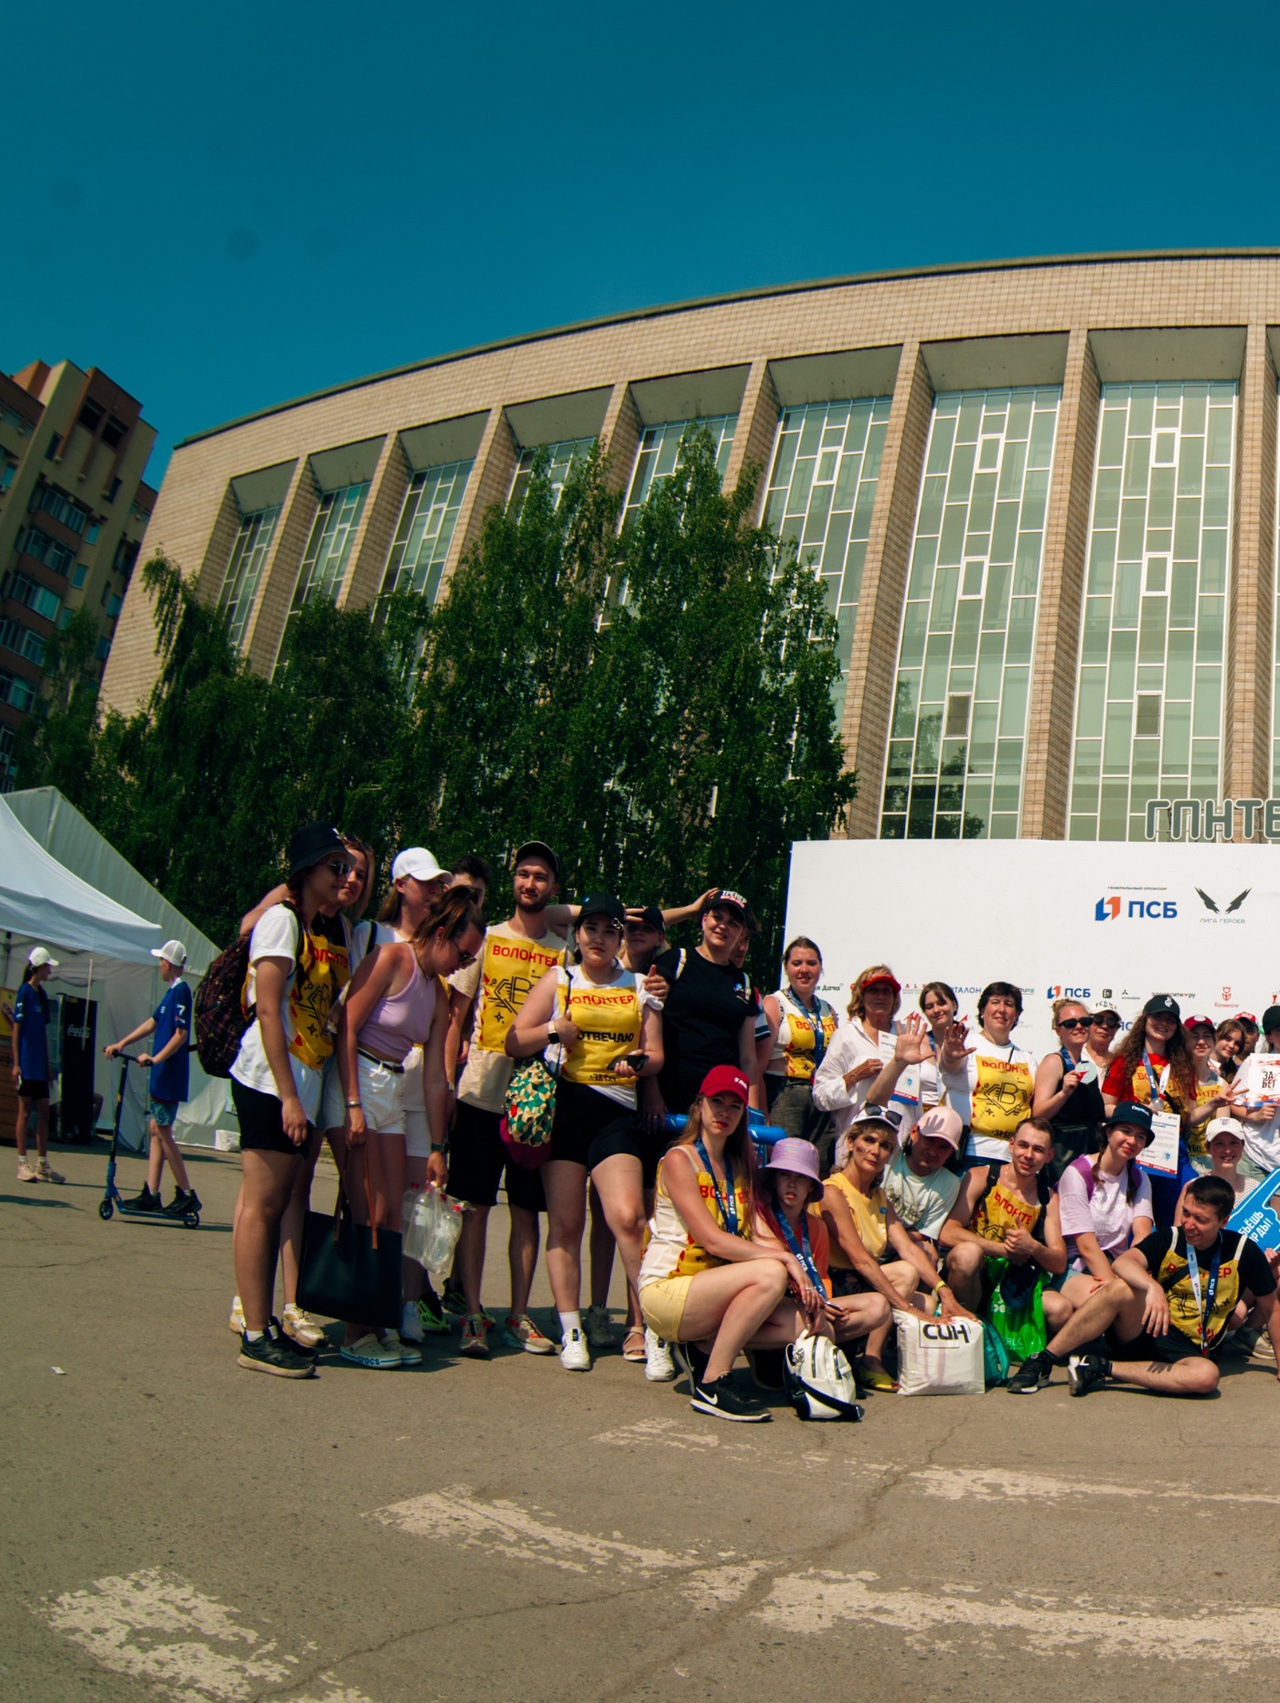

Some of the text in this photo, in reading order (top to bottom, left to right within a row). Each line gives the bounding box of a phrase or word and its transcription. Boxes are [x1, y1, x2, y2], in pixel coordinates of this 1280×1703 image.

[1128, 901, 1178, 918] ПСБ
[492, 945, 558, 968] ВОЛОНТЕР
[1065, 988, 1091, 998] ПСБ
[564, 994, 635, 1006] ВОЛОНТЕР
[358, 1356, 380, 1366] crocs
